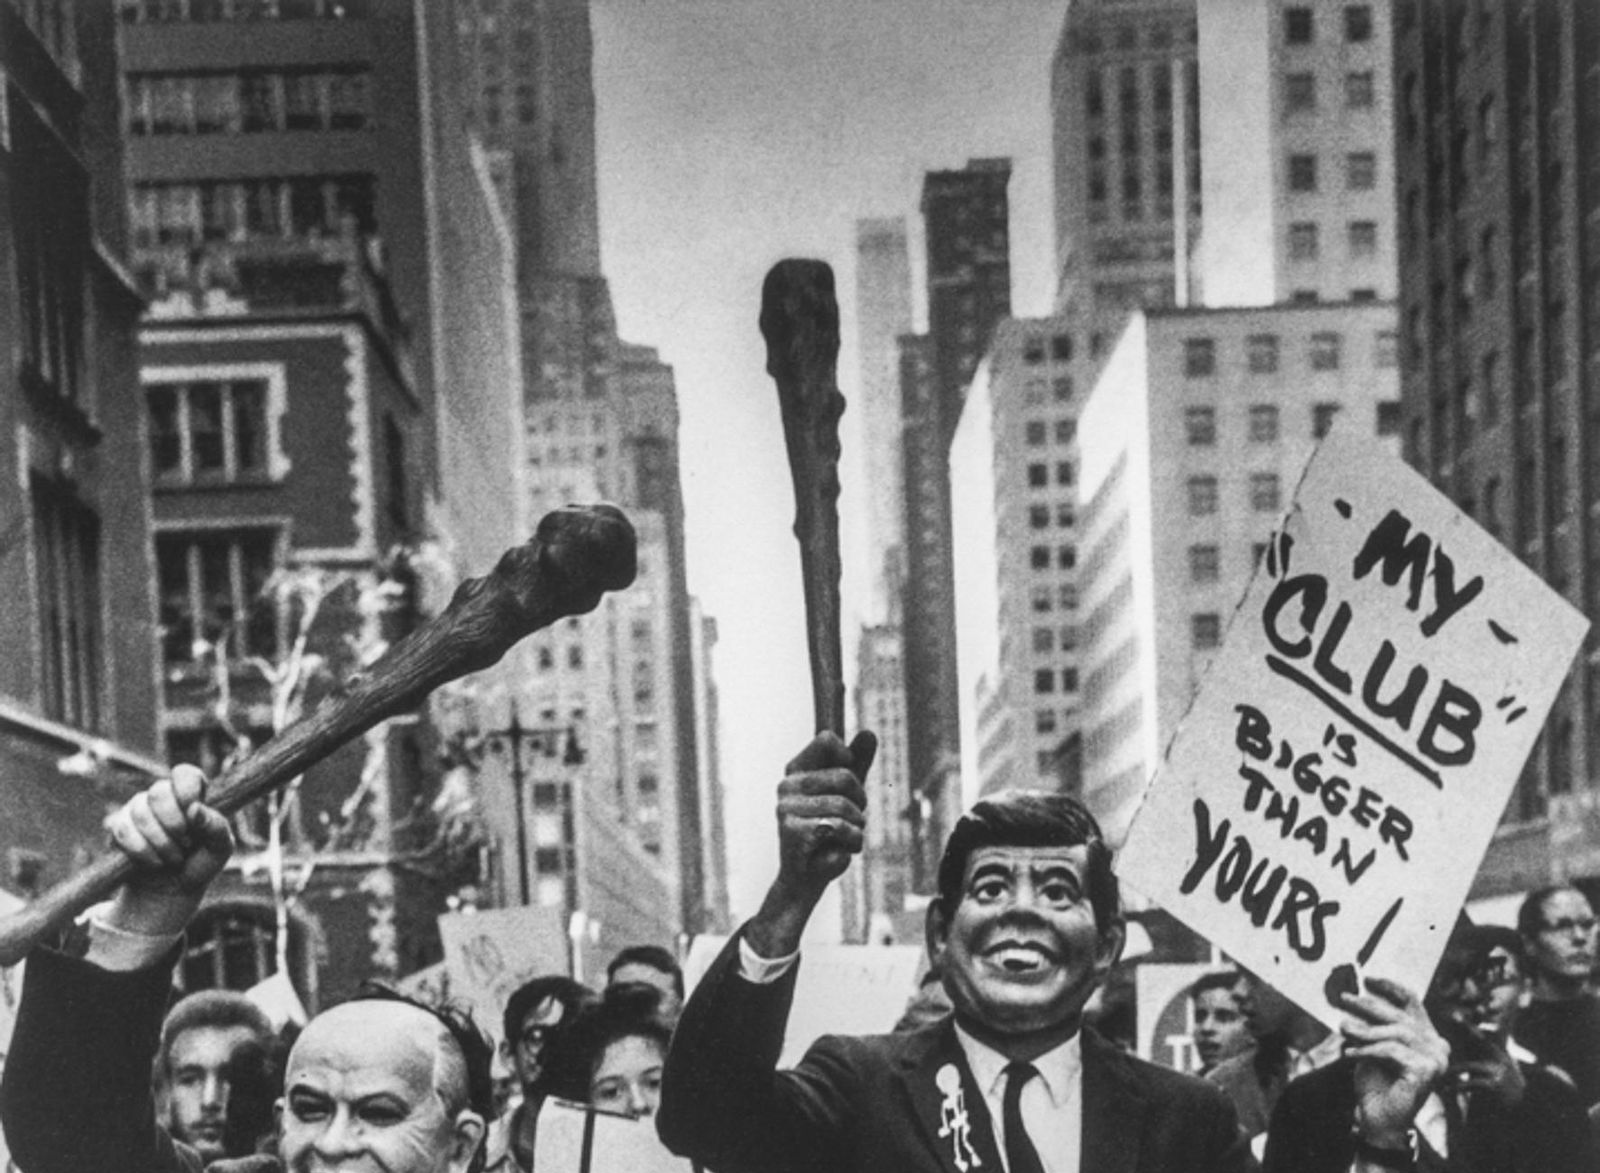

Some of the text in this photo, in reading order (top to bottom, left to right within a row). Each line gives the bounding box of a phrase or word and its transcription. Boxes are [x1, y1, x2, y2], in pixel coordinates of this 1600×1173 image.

[1353, 510, 1484, 637] MY
[1235, 703, 1413, 861] BIGGER
[1323, 723, 1358, 767] IS
[1239, 764, 1376, 885] THAN
